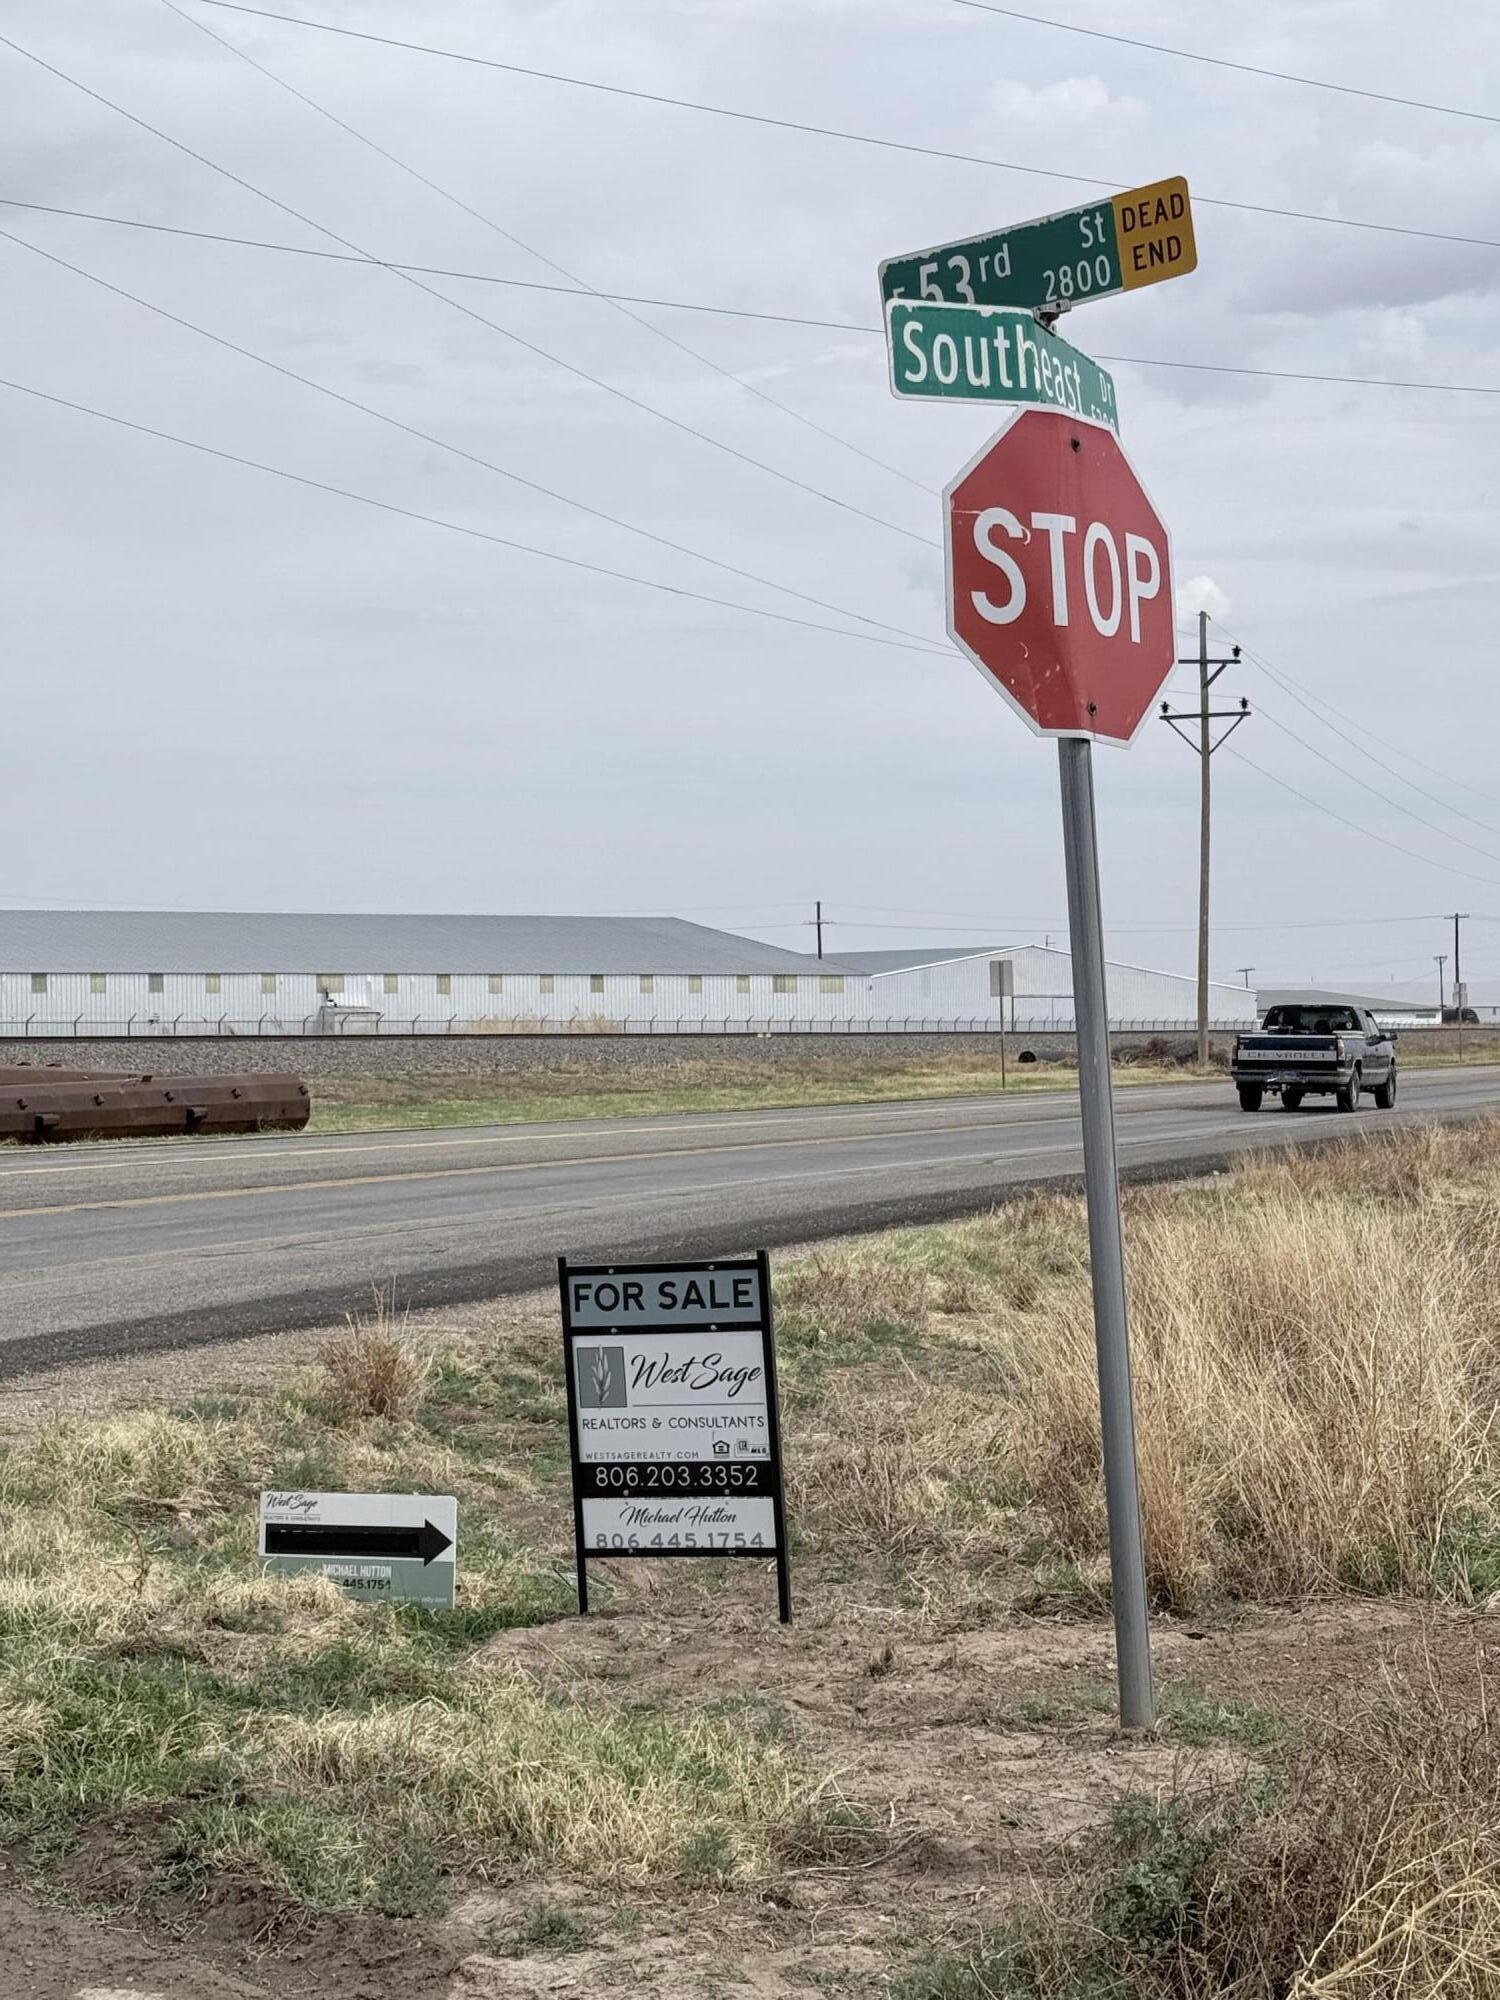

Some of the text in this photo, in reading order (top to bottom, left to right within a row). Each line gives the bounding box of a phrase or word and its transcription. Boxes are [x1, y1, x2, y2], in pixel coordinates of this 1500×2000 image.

[1121, 193, 1185, 233] DEAD
[920, 211, 1106, 304] 53rd St
[1133, 236, 1182, 271] END
[1042, 255, 1111, 301] 2800
[970, 507, 1161, 644] STOP
[1248, 1051, 1325, 1059] CHVROLET
[573, 1278, 754, 1313] FOR SALE
[582, 1415, 765, 1430] REALTORS & CONSULTANTS
[585, 1450, 700, 1460] WESTSAGEREALTY.COM
[595, 1465, 759, 1487] 806.203.3352
[619, 1505, 738, 1528] Michael Hutton
[595, 1532, 765, 1549] 806.445.1754
[323, 1564, 392, 1578] MICHAEL HUTTON
